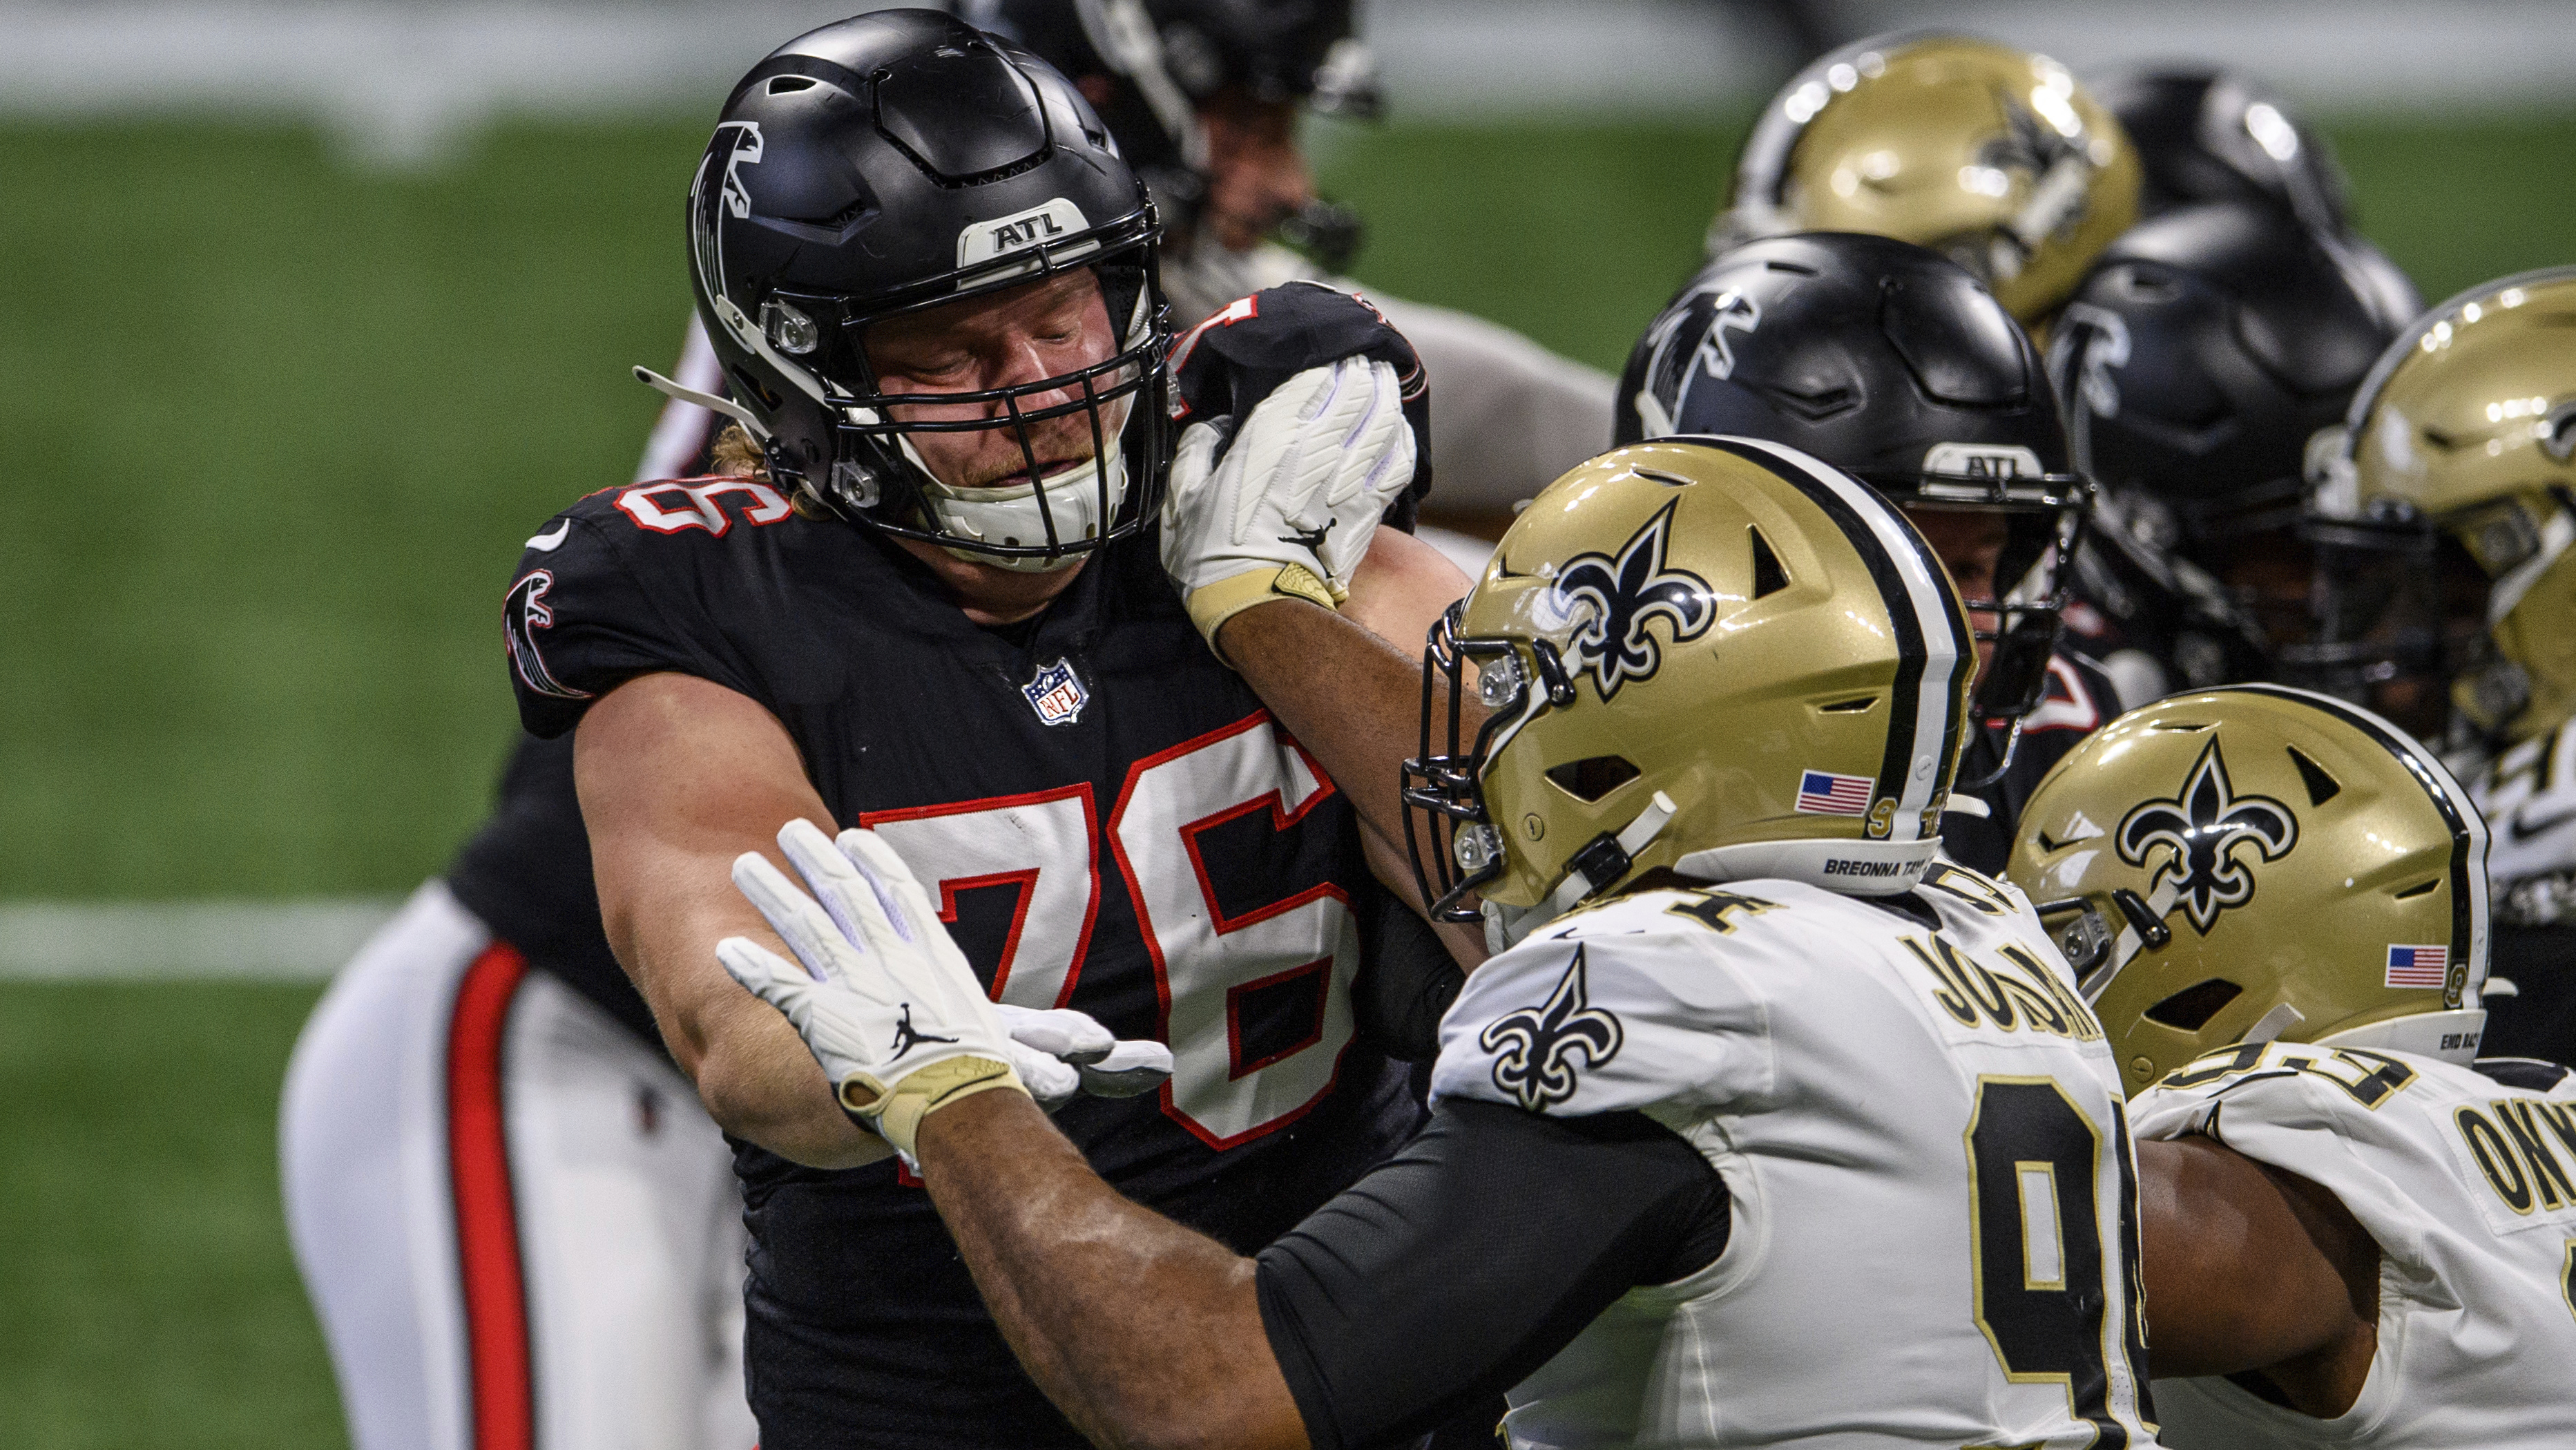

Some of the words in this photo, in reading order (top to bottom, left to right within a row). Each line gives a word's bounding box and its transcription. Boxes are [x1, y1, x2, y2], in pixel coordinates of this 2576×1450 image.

[990, 213, 1063, 253] ATL
[1039, 684, 1079, 718] NFL
[1823, 859, 1900, 877] BREONNA
[859, 708, 1361, 1167] 76
